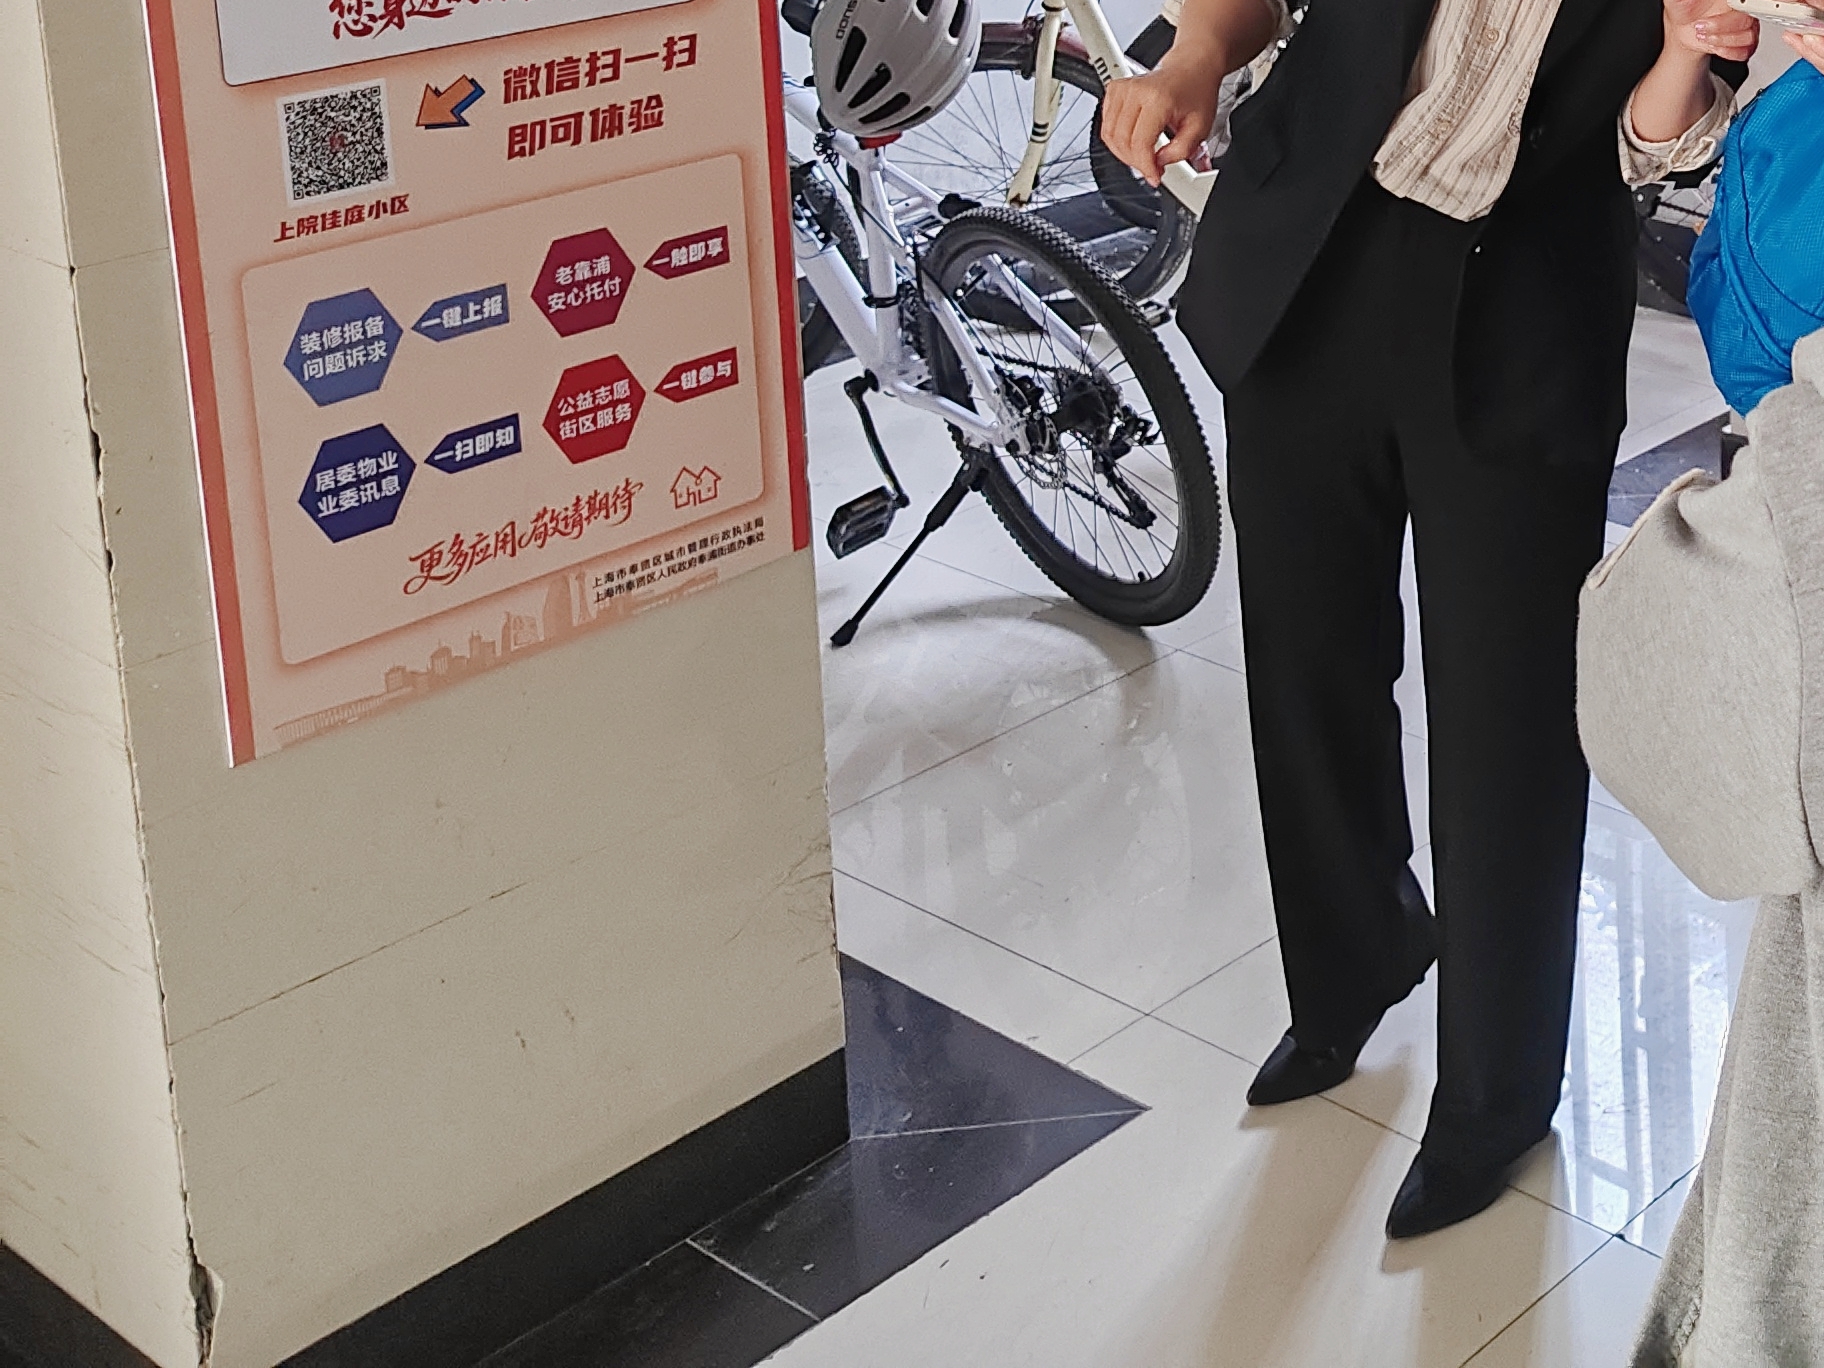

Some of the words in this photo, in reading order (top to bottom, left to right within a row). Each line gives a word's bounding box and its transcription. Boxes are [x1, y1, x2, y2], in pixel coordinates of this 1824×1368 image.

[502, 33, 698, 105] 微信扫一扫
[506, 94, 665, 161] 即可体验
[274, 194, 409, 243] 上院佳庭小区
[555, 255, 611, 286] 老靠浦
[653, 237, 723, 268] 一触即享
[421, 295, 502, 329] 一键上报
[548, 276, 621, 314] 安心托付
[300, 316, 384, 354] 装修报备
[303, 341, 387, 381] 问题诉求
[663, 360, 732, 390] 一键参与
[558, 379, 630, 416] 公益志愿
[559, 403, 632, 440] 街区服务
[434, 426, 514, 462] 一扫即知
[315, 451, 398, 493] 居委物业
[318, 475, 400, 518] 业委讯息
